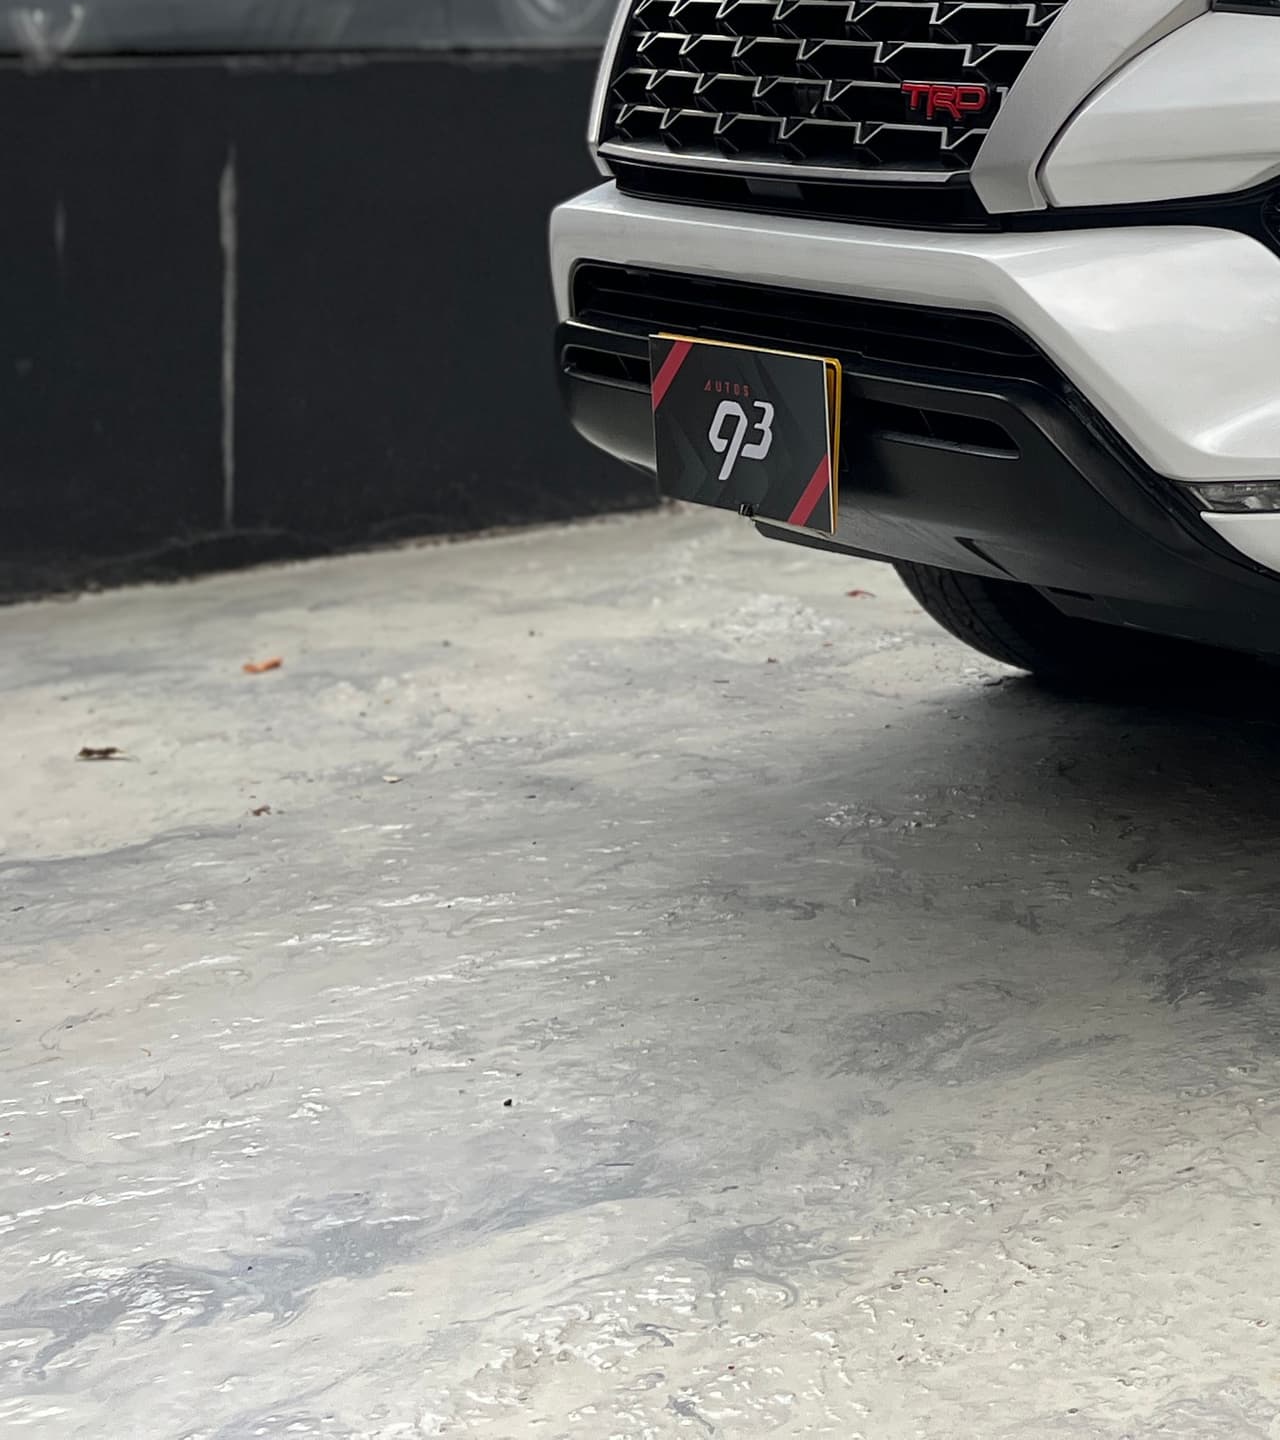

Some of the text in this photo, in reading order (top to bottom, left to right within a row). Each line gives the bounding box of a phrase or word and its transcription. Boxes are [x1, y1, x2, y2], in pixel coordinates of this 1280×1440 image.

[901, 82, 988, 122] TRD
[703, 379, 750, 398] AUTOS
[707, 400, 775, 481] 93
